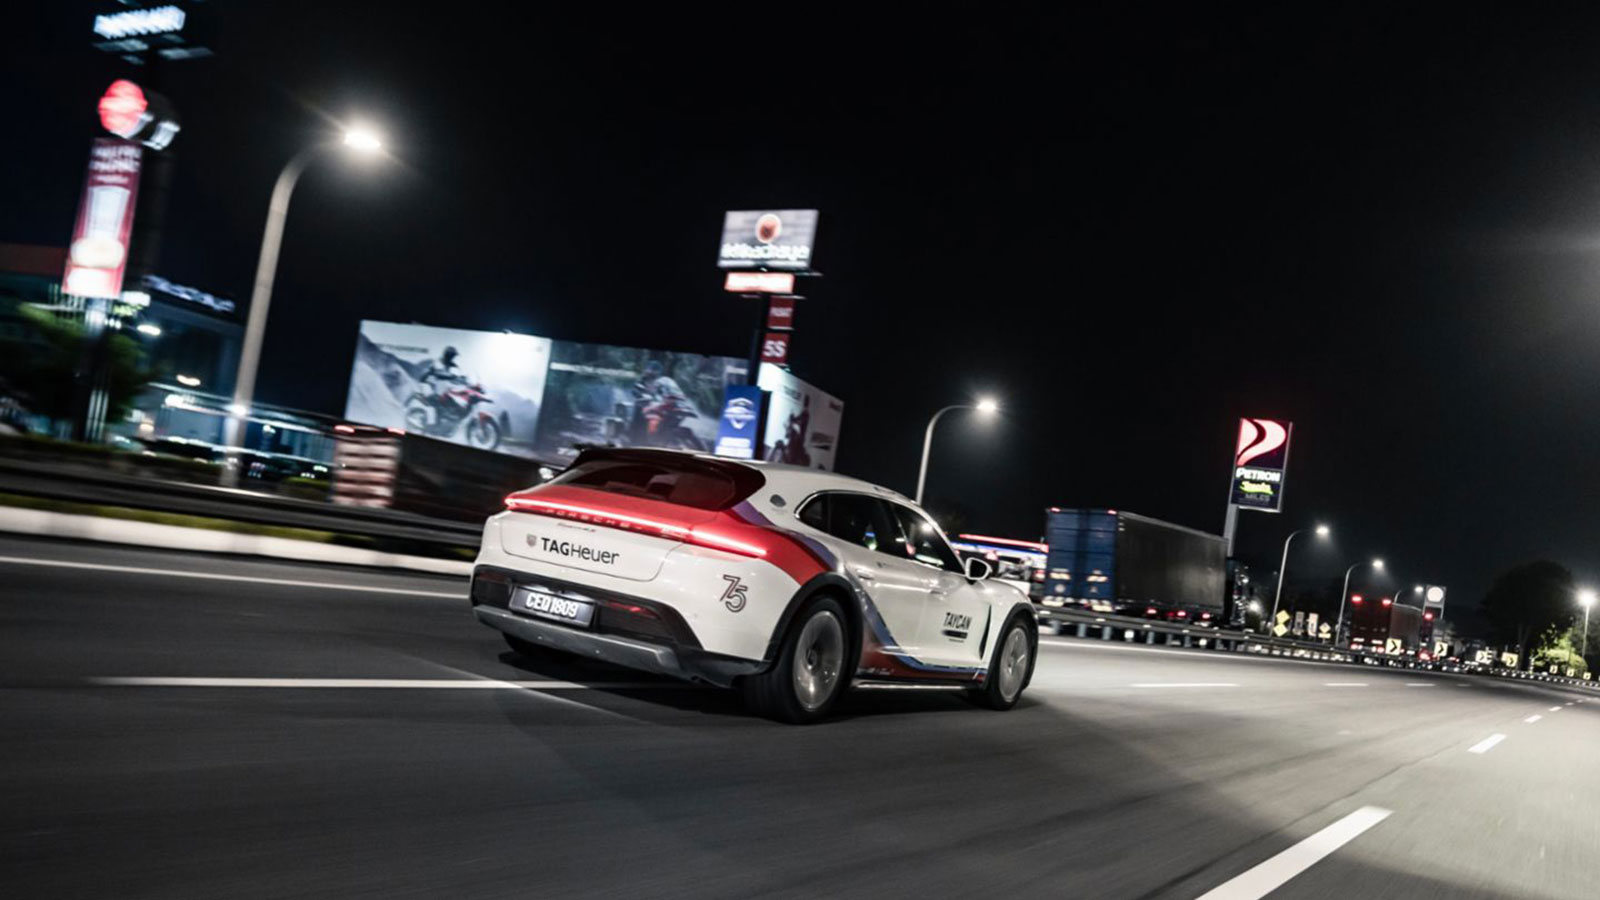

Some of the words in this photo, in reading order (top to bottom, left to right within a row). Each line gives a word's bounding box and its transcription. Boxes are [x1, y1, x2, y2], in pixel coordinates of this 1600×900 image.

[762, 341, 787, 357] 5S
[1236, 467, 1281, 482] PETRON
[720, 574, 748, 613] 75
[943, 612, 972, 630] TAYCAN
